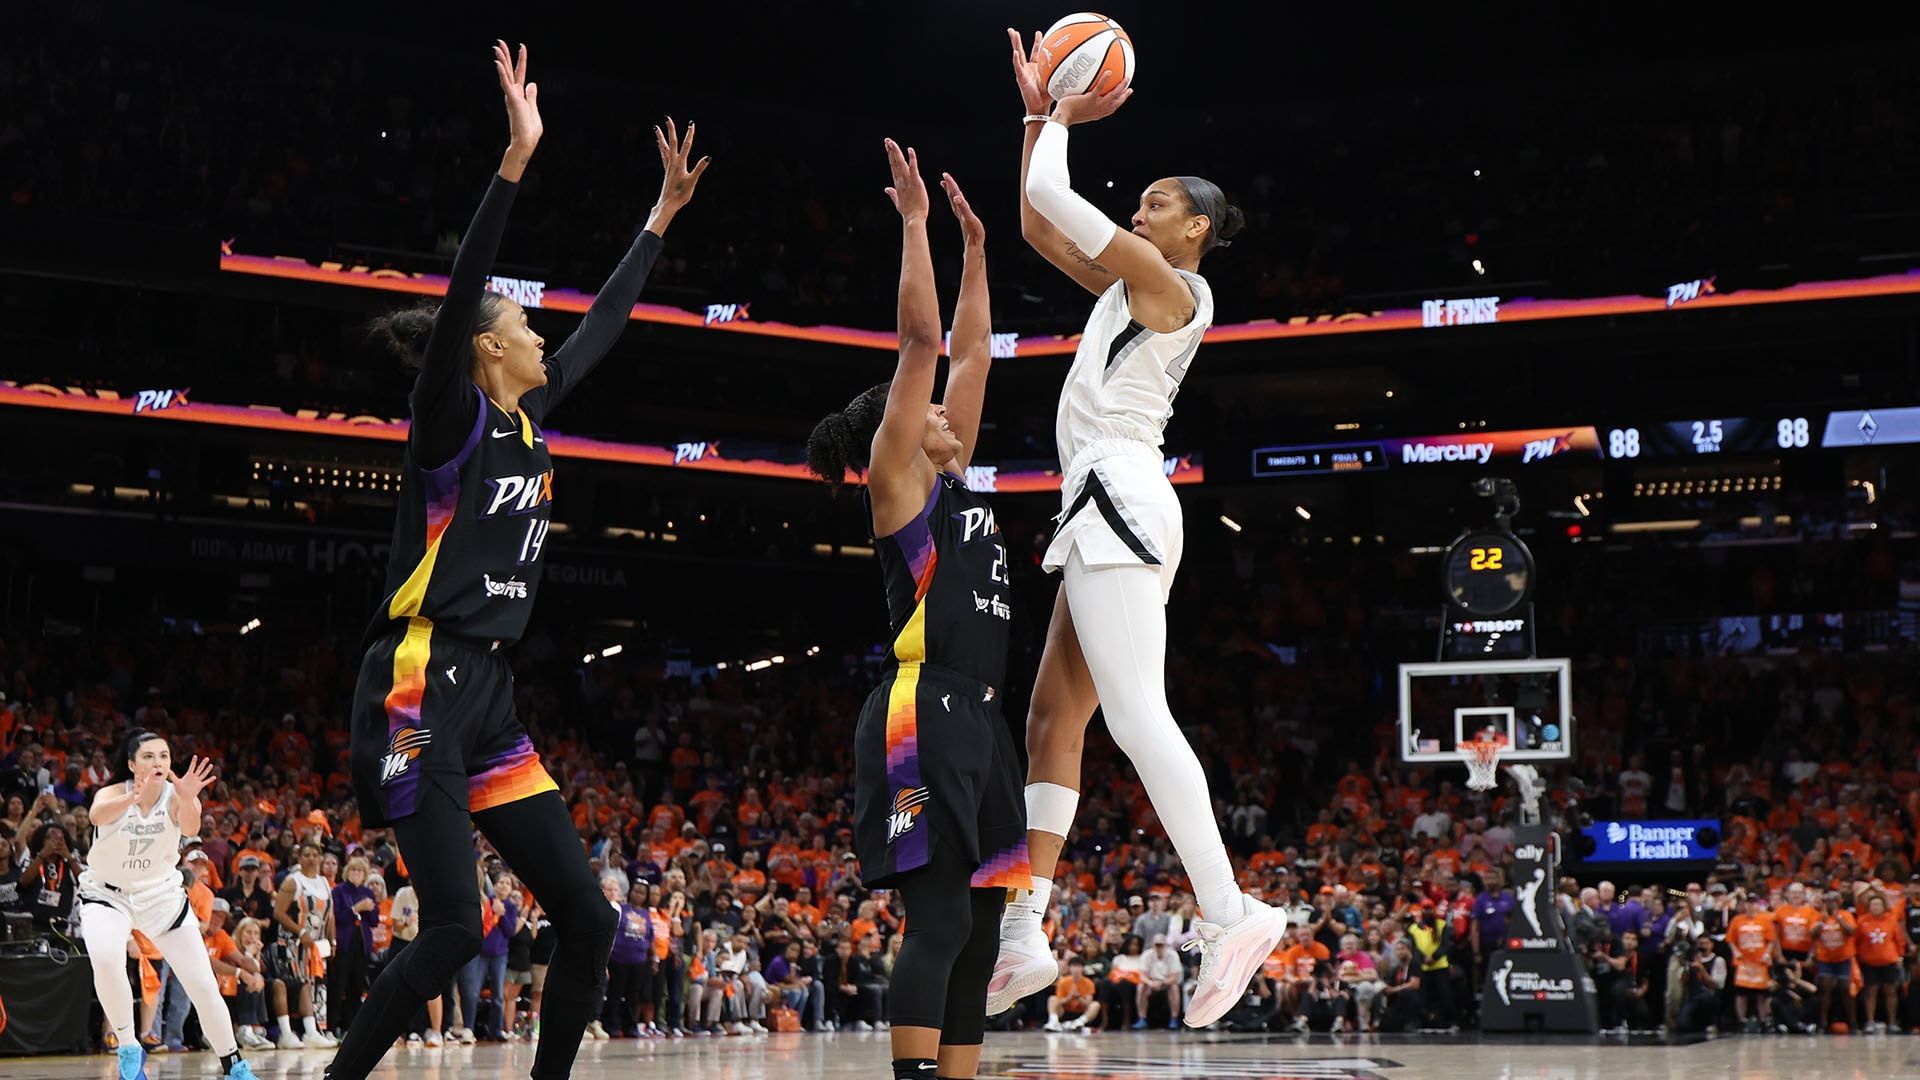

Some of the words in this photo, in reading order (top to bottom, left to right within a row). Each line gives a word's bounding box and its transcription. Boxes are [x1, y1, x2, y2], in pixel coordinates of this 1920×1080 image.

[705, 302, 751, 326] PHX
[1422, 296, 1500, 328] DEFENSE
[135, 388, 190, 413] PHX
[1402, 442, 1494, 465] Mercury
[1522, 432, 1575, 464] PHX
[1609, 428, 1640, 459] 88
[1691, 420, 1723, 445] 2.5
[1777, 417, 1809, 448] 88
[675, 440, 720, 465] PHX
[486, 468, 554, 515] PHX
[519, 518, 550, 562] 14
[546, 562, 627, 588] EQUILA
[121, 821, 166, 836] ACES
[1629, 824, 1695, 842] Banner
[128, 839, 155, 857] 17
[1514, 844, 1545, 863] ally
[1629, 840, 1689, 860] Health
[1509, 979, 1574, 991] FINALS
